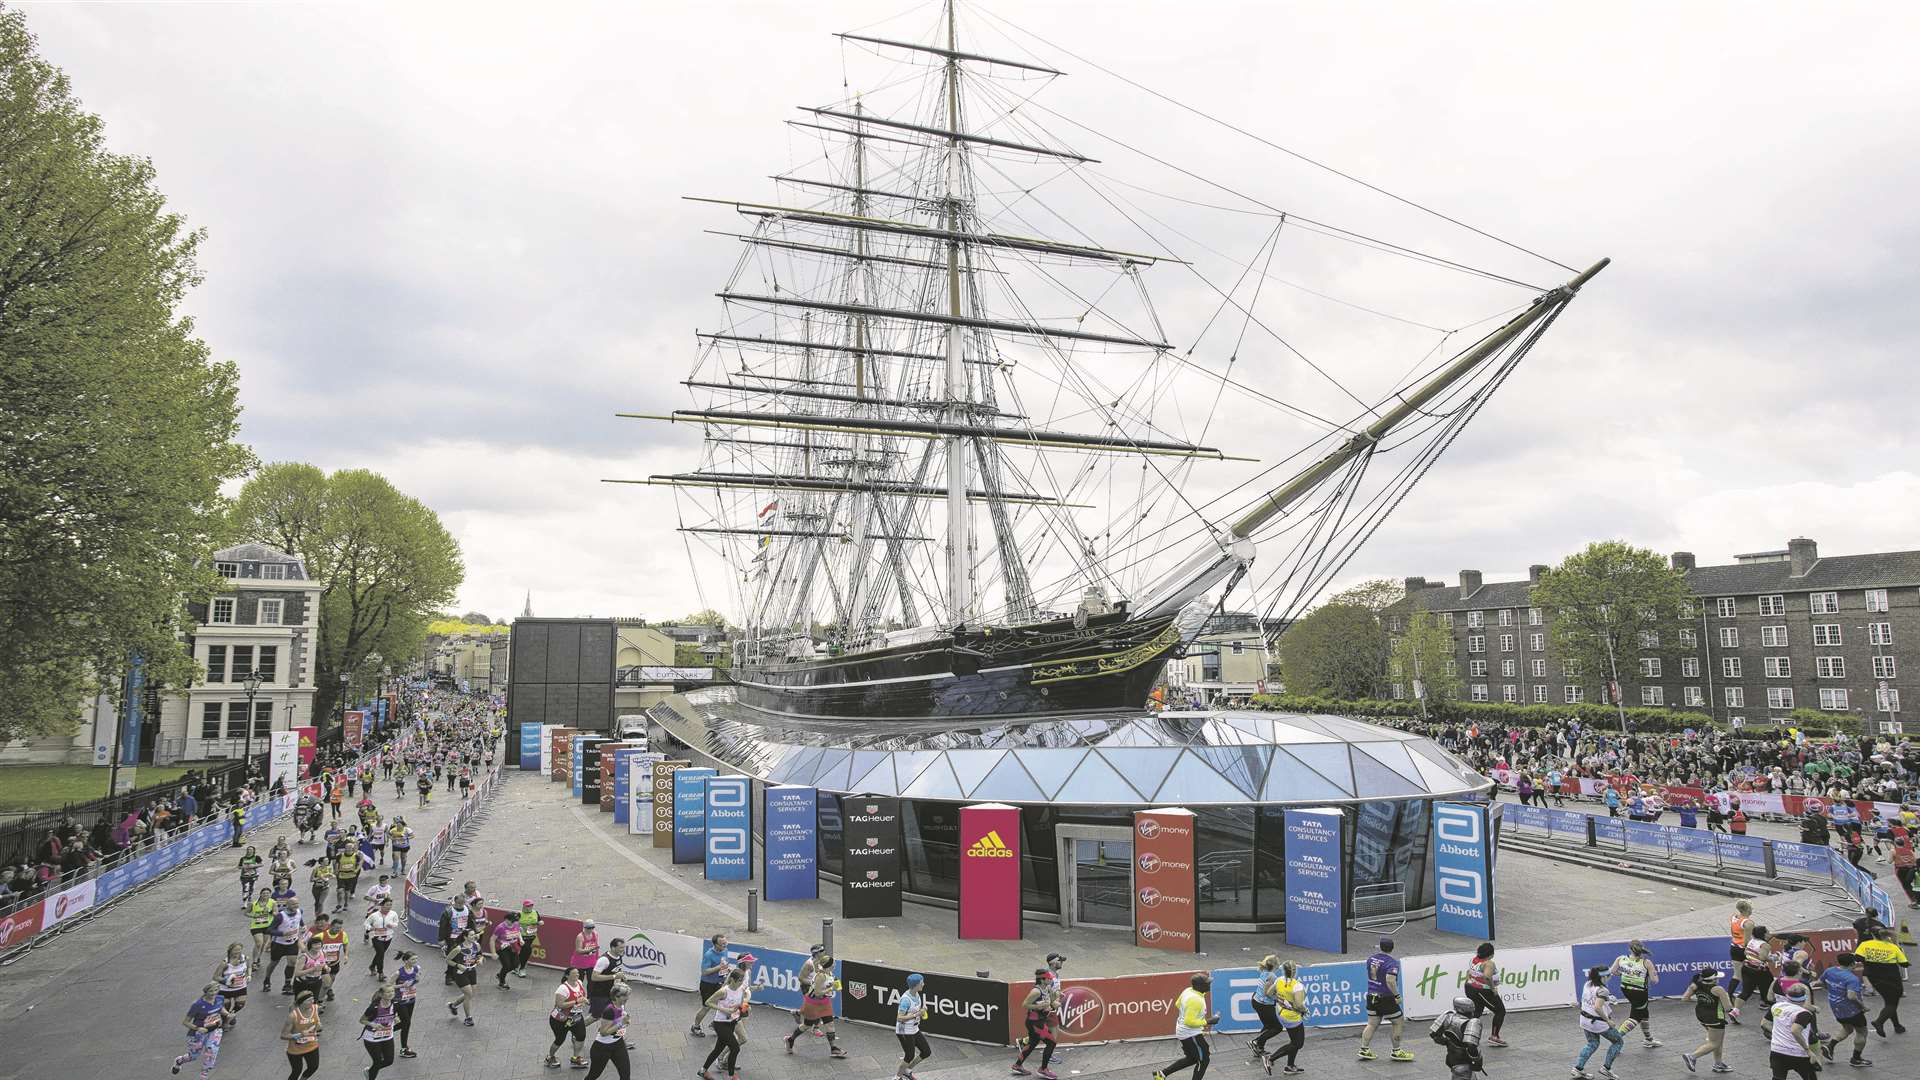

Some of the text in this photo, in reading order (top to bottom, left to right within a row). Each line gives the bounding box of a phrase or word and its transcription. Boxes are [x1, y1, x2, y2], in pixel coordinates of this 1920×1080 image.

[711, 810, 745, 818] Abbott
[1302, 820, 1322, 828] TATA
[1161, 827, 1190, 835] money
[1288, 826, 1336, 837] CONSULTANCY
[1297, 834, 1328, 842] SERVICES
[967, 848, 1013, 858] adidas
[1440, 844, 1479, 857] Abbott
[1161, 861, 1190, 870] money
[1289, 860, 1336, 872] CONSULTANCY
[1298, 868, 1328, 878] SERVICES
[1162, 895, 1191, 904] money
[1303, 891, 1323, 899] TATA
[1290, 896, 1336, 908] CONSULTANCY
[1298, 904, 1328, 914] SERVICES
[1442, 903, 1483, 918] Abbott
[1163, 929, 1191, 940] money
[1821, 939, 1852, 952] RUN
[624, 944, 666, 966] uxton
[1457, 967, 1528, 988] Hday
[1532, 964, 1560, 983] Inn
[1303, 990, 1368, 1006] ARATH
[1056, 993, 1173, 1028] Virgin money
[1310, 1004, 1360, 1018] AJORS
